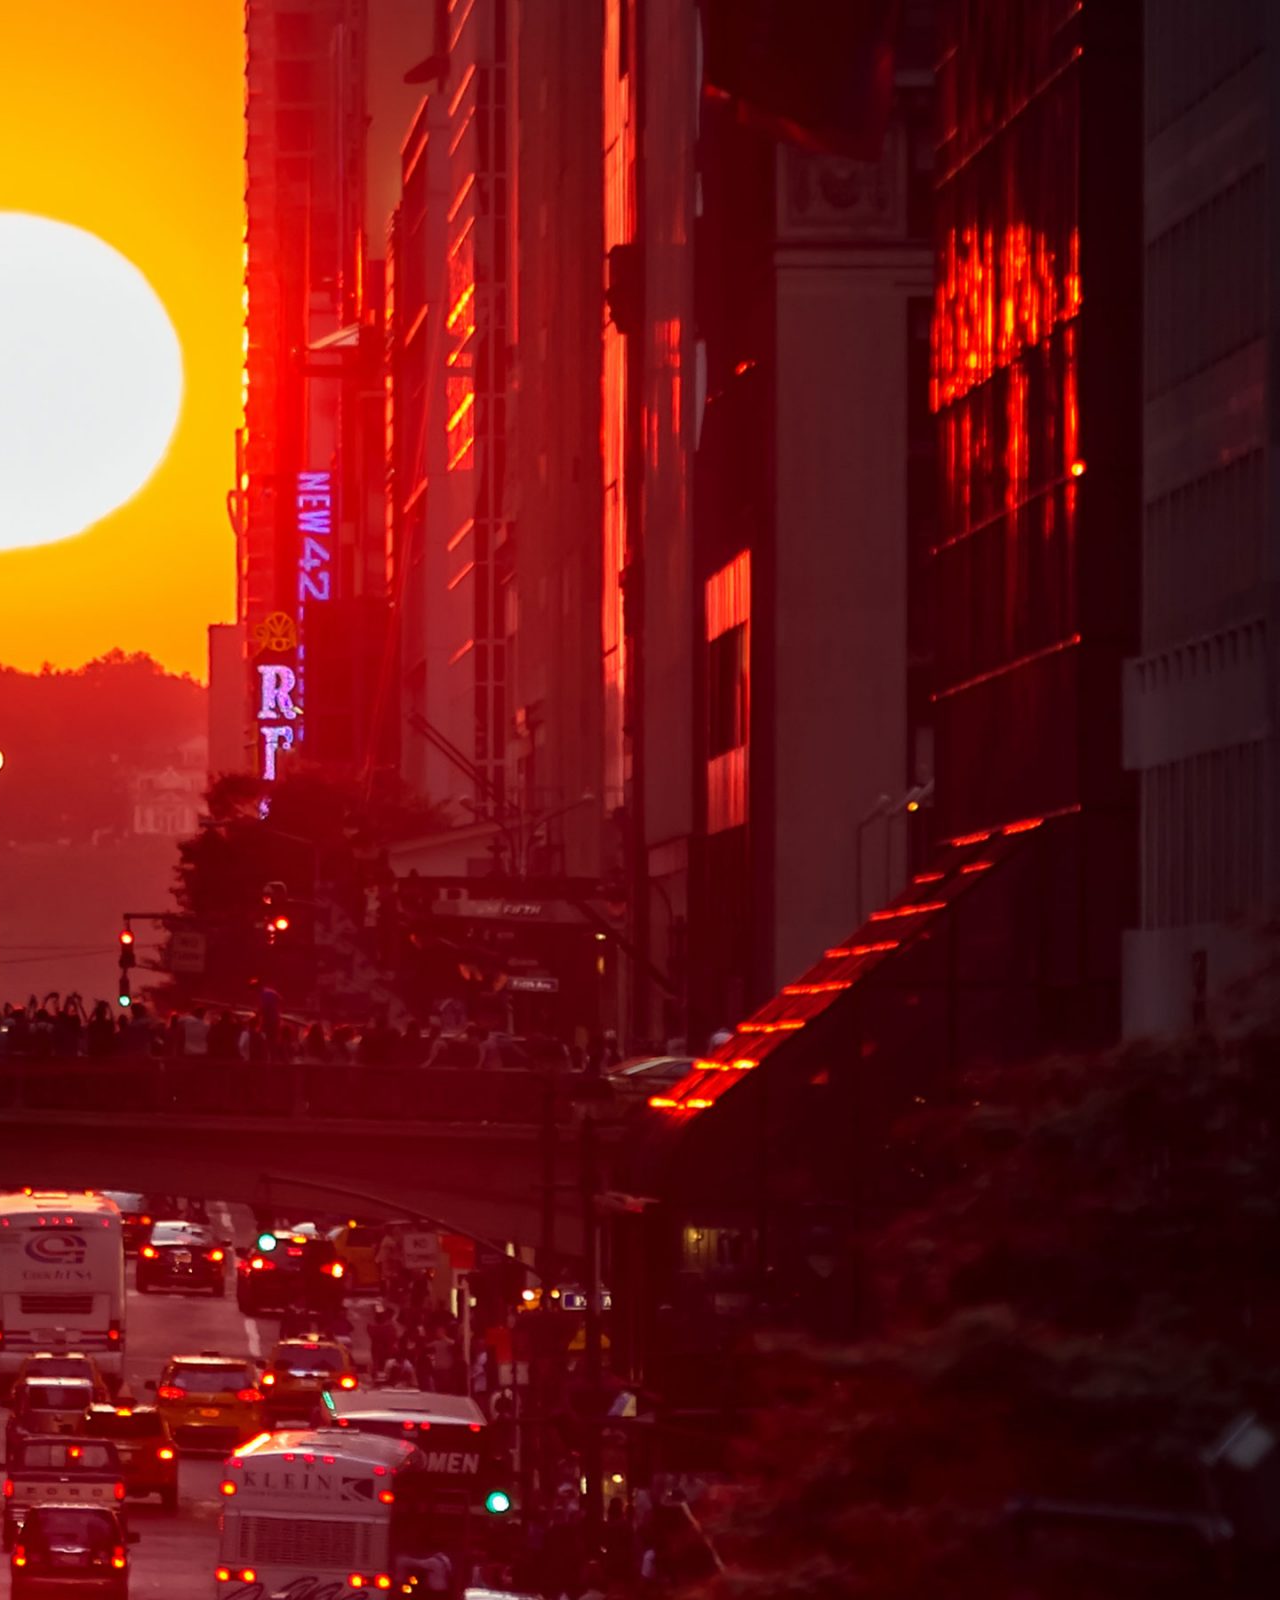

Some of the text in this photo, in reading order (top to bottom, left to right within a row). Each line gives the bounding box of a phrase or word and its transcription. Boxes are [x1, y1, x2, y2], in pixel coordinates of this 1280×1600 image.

[297, 472, 331, 601] NEW 42
[243, 1472, 333, 1491] KLEIN
